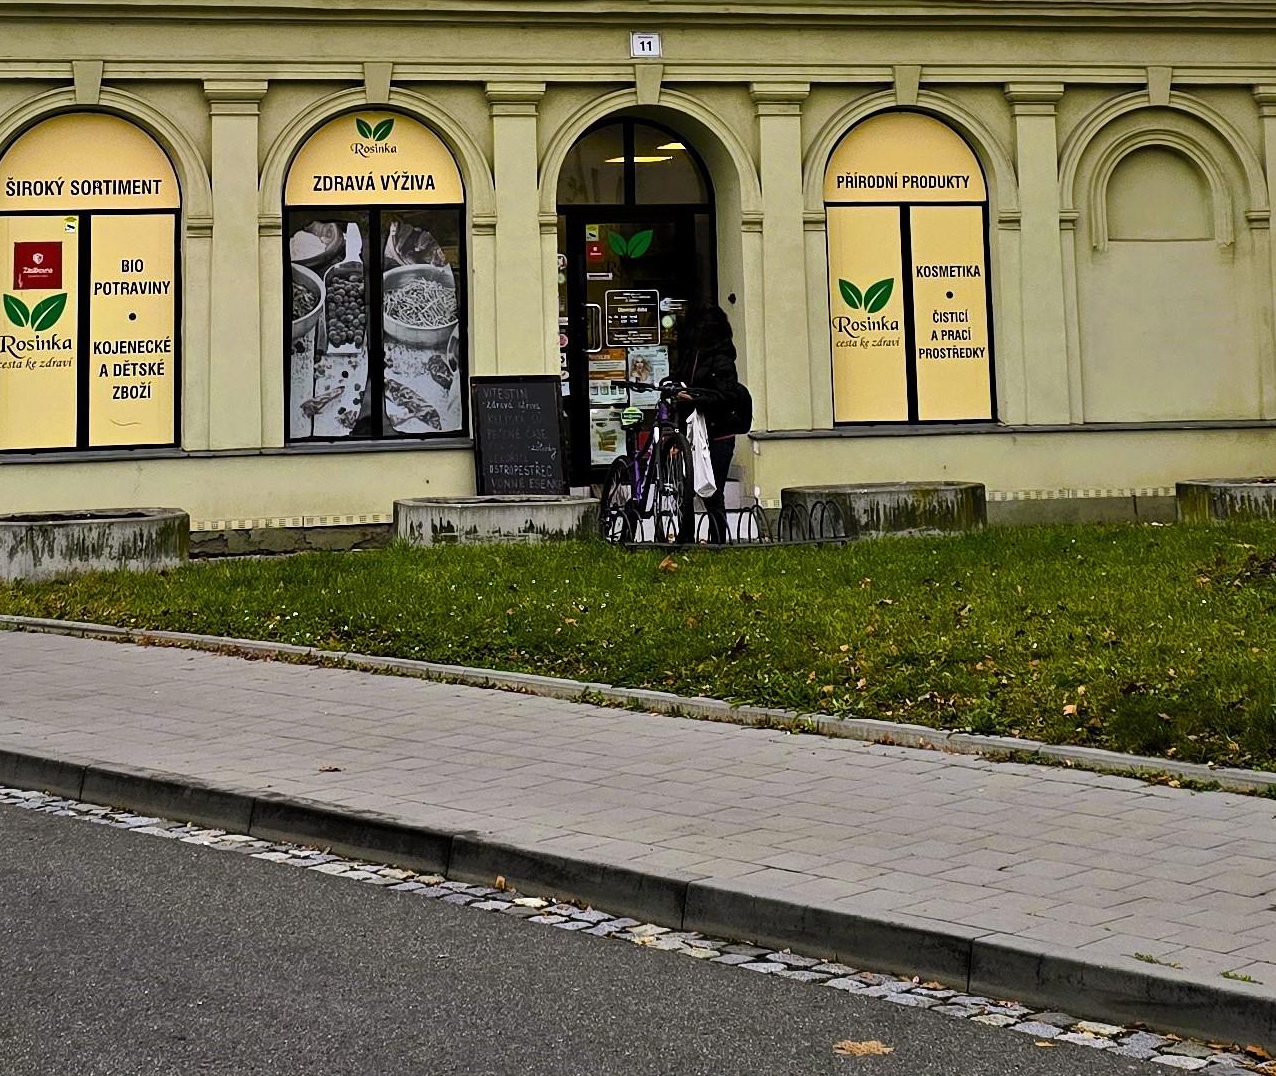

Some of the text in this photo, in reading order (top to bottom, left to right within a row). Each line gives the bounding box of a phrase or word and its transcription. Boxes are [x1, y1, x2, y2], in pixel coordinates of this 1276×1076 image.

[639, 40, 652, 52] 11
[350, 142, 397, 158] Rosinka
[5, 176, 162, 197] ŠIROKÝ SORTIMENT
[313, 170, 436, 192] ZDRAVÁ VÝŽIVA
[836, 172, 970, 189] PŘÍRODNÍ PRODUKTY
[121, 259, 144, 273] BIO
[916, 265, 981, 278] KOSMETIKA
[93, 281, 171, 296] POTRAVINY
[932, 309, 968, 323] ČISTICÍ
[832, 315, 899, 339] Rosinka
[931, 326, 971, 341] A PRACÍ
[93, 336, 172, 355] KOJENECKÉ
[835, 336, 900, 349] cesta ke zdraví
[918, 345, 986, 359] PROSTŘEDKY
[25, 357, 37, 370] ke
[39, 356, 73, 368] zdraví
[99, 359, 165, 377] A DĚTSKÉ
[113, 382, 151, 399] ZBOŽÍ
